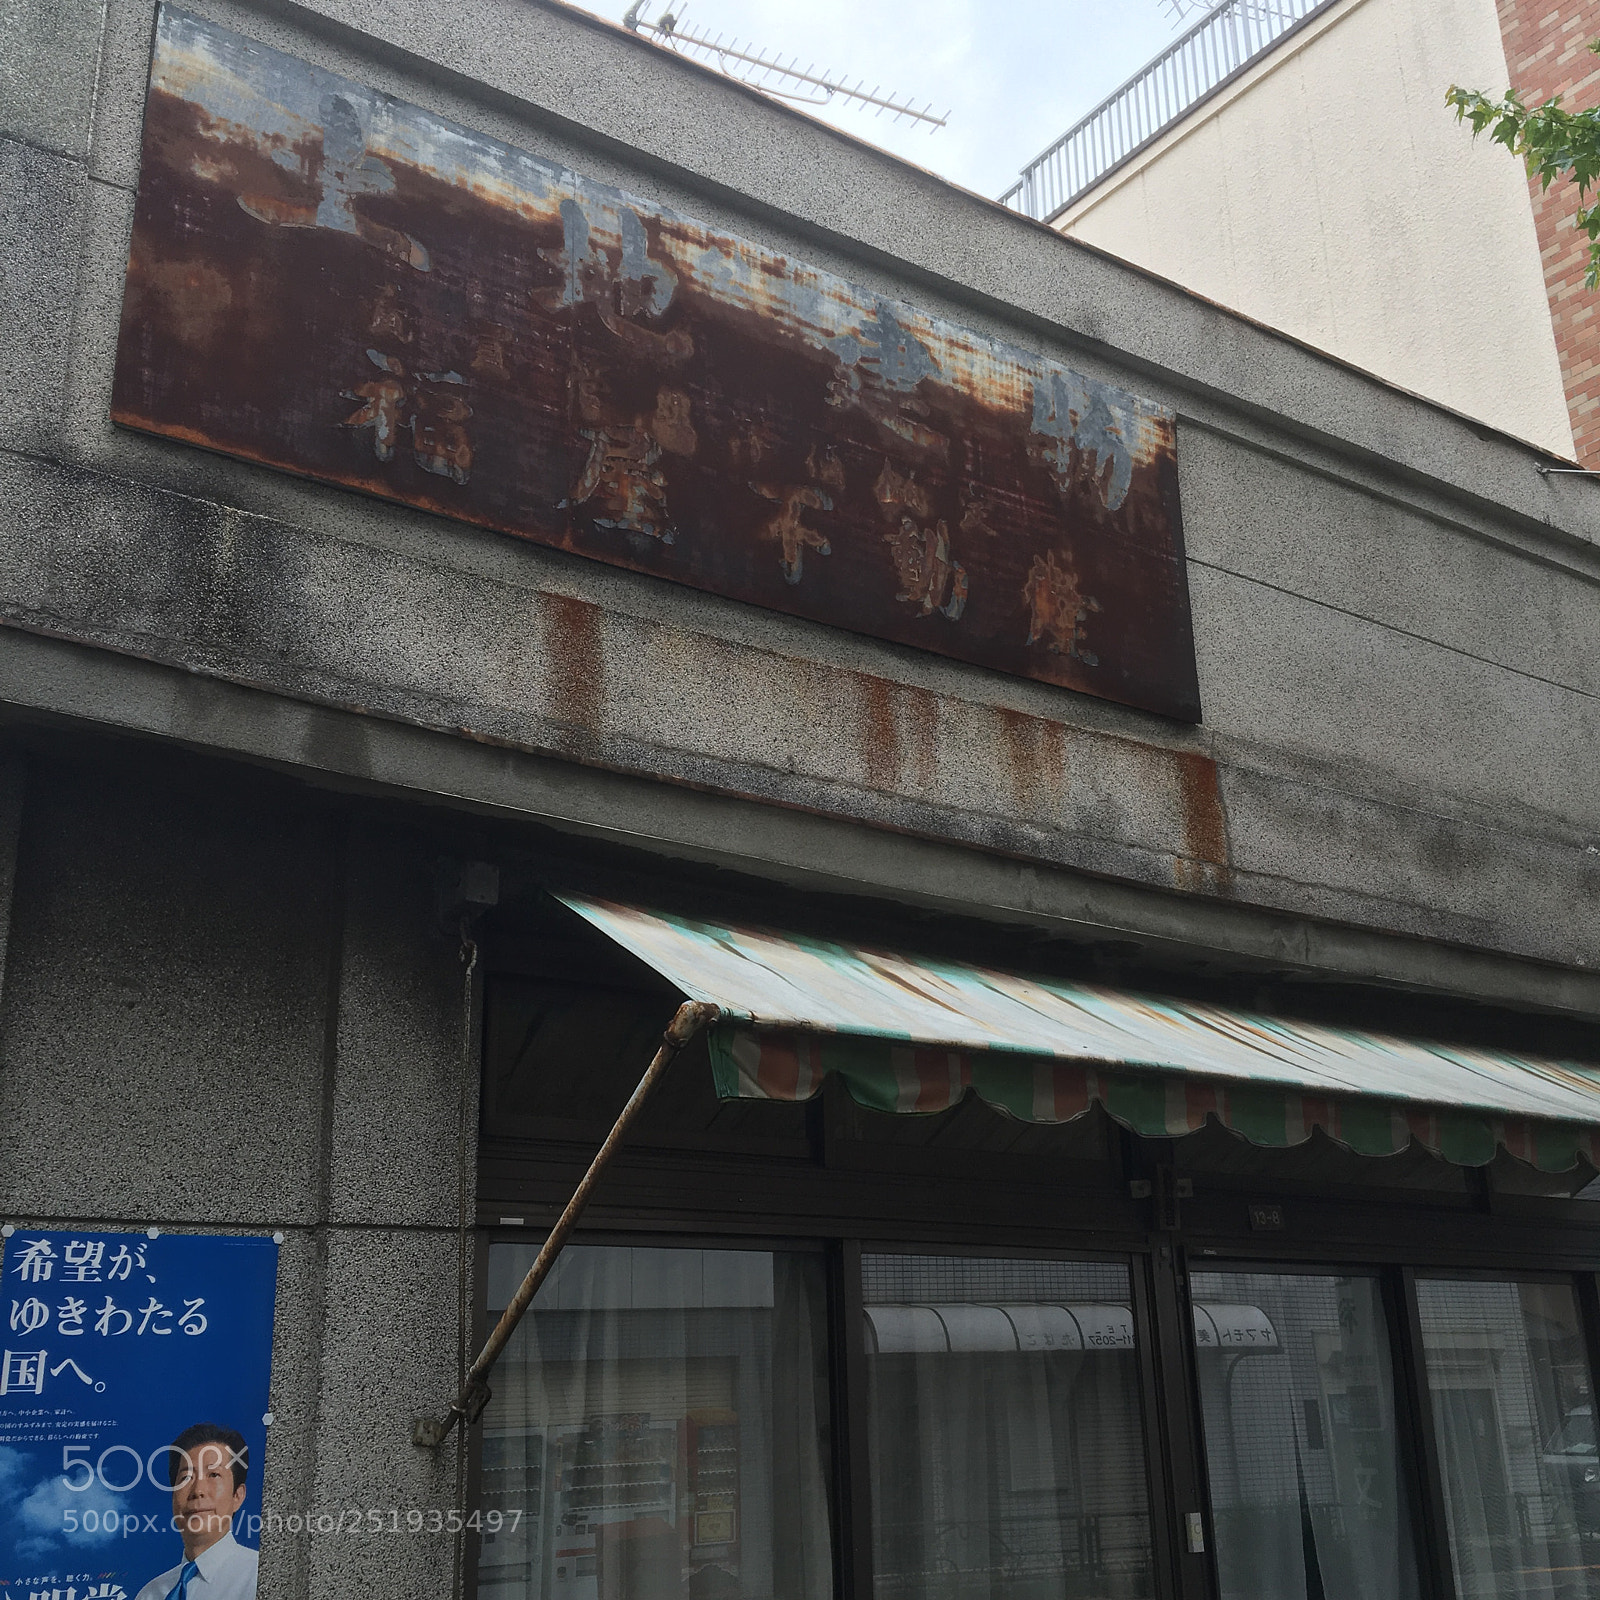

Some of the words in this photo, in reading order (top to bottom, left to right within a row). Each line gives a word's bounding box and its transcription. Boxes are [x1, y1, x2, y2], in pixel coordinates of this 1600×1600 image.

[10, 1238, 156, 1284] 希望が、
[9, 1295, 208, 1337] ゆきわたる
[0, 1349, 106, 1395] 国へ。
